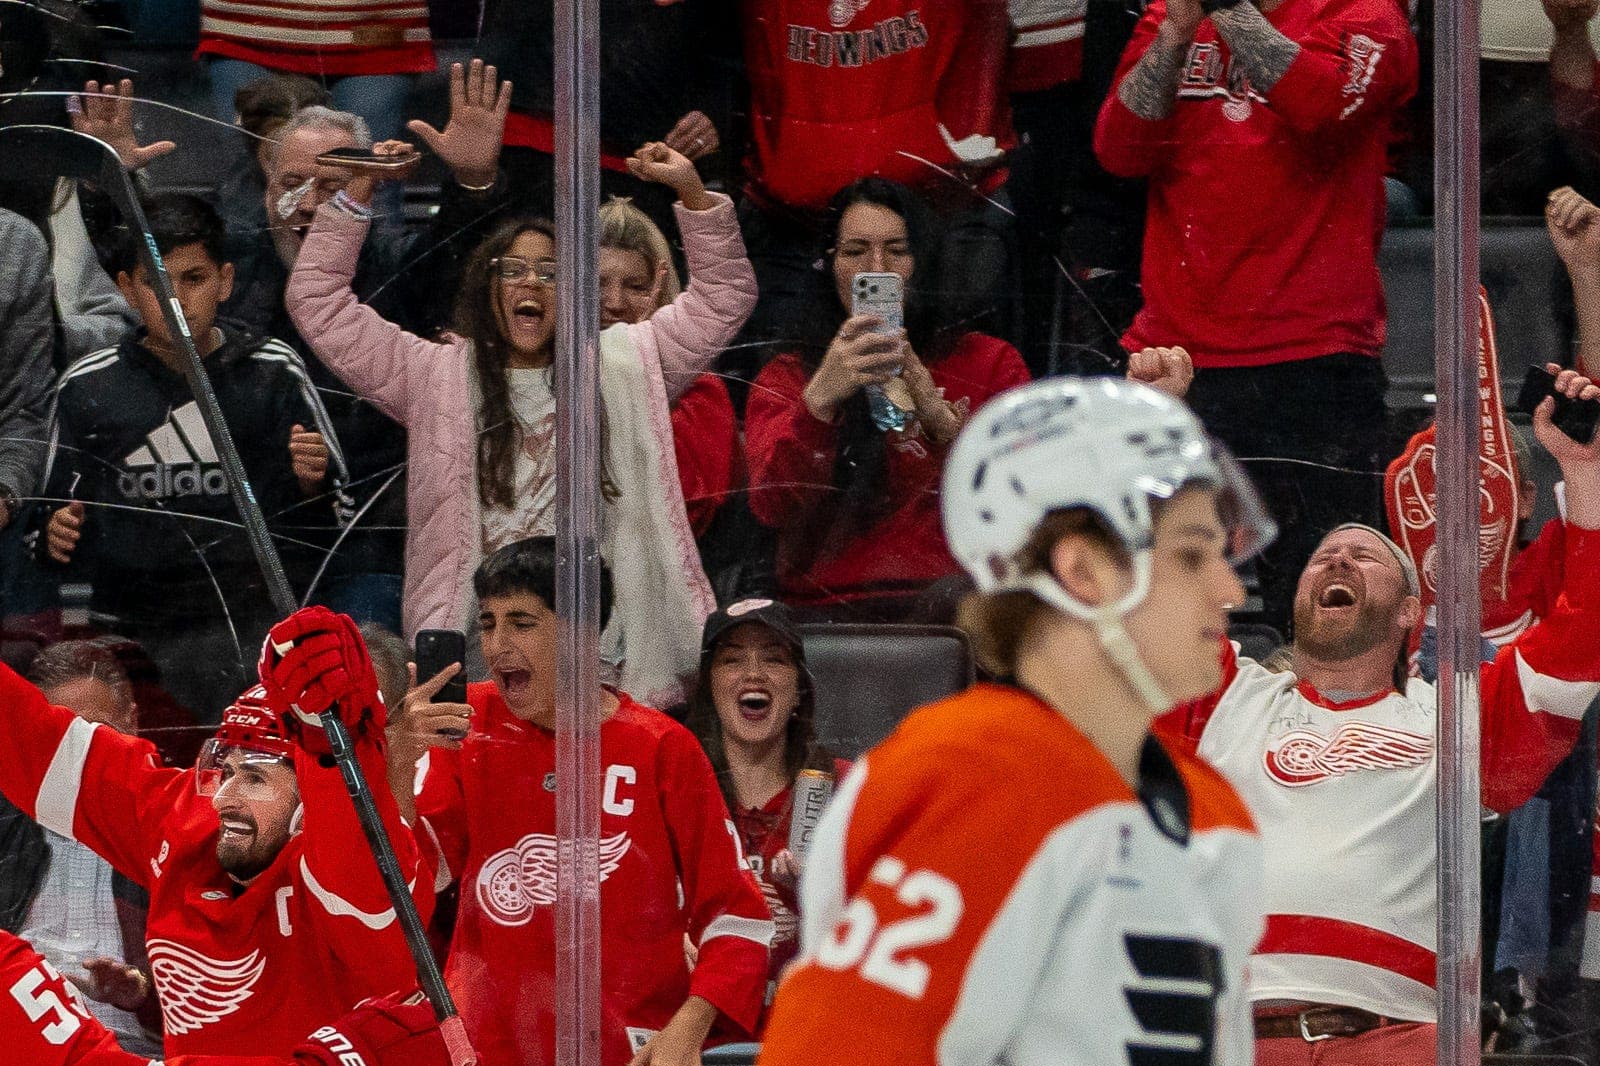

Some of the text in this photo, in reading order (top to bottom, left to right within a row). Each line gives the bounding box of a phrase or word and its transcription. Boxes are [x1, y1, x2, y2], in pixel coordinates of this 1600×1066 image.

[119, 463, 228, 499] adida
[226, 713, 261, 726] CCM
[602, 763, 637, 817] C
